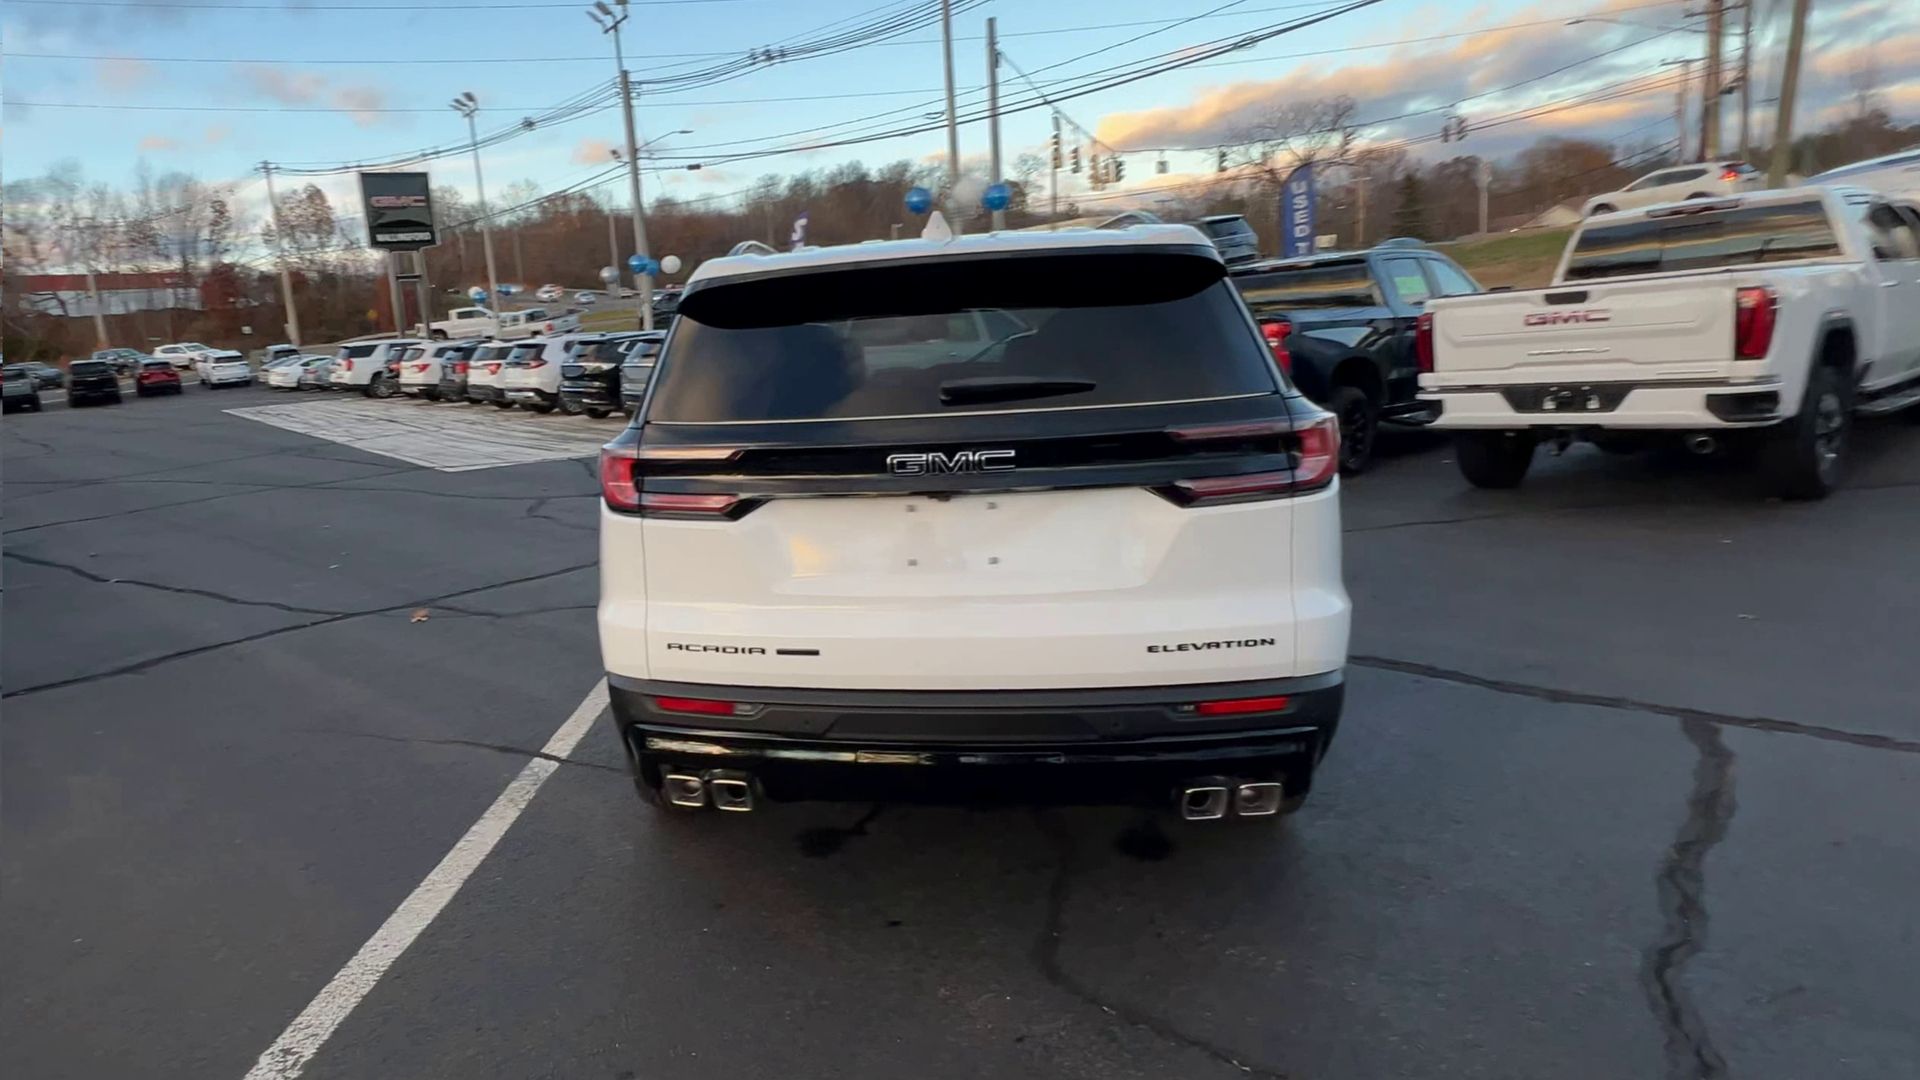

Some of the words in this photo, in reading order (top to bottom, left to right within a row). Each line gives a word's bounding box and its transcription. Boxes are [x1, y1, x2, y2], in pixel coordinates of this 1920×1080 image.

[1291, 180, 1311, 238] USED
[1524, 309, 1610, 326] GMC
[886, 450, 1016, 476] GMC
[667, 643, 766, 655] ACADIA
[1147, 638, 1275, 653] ELEVATION
